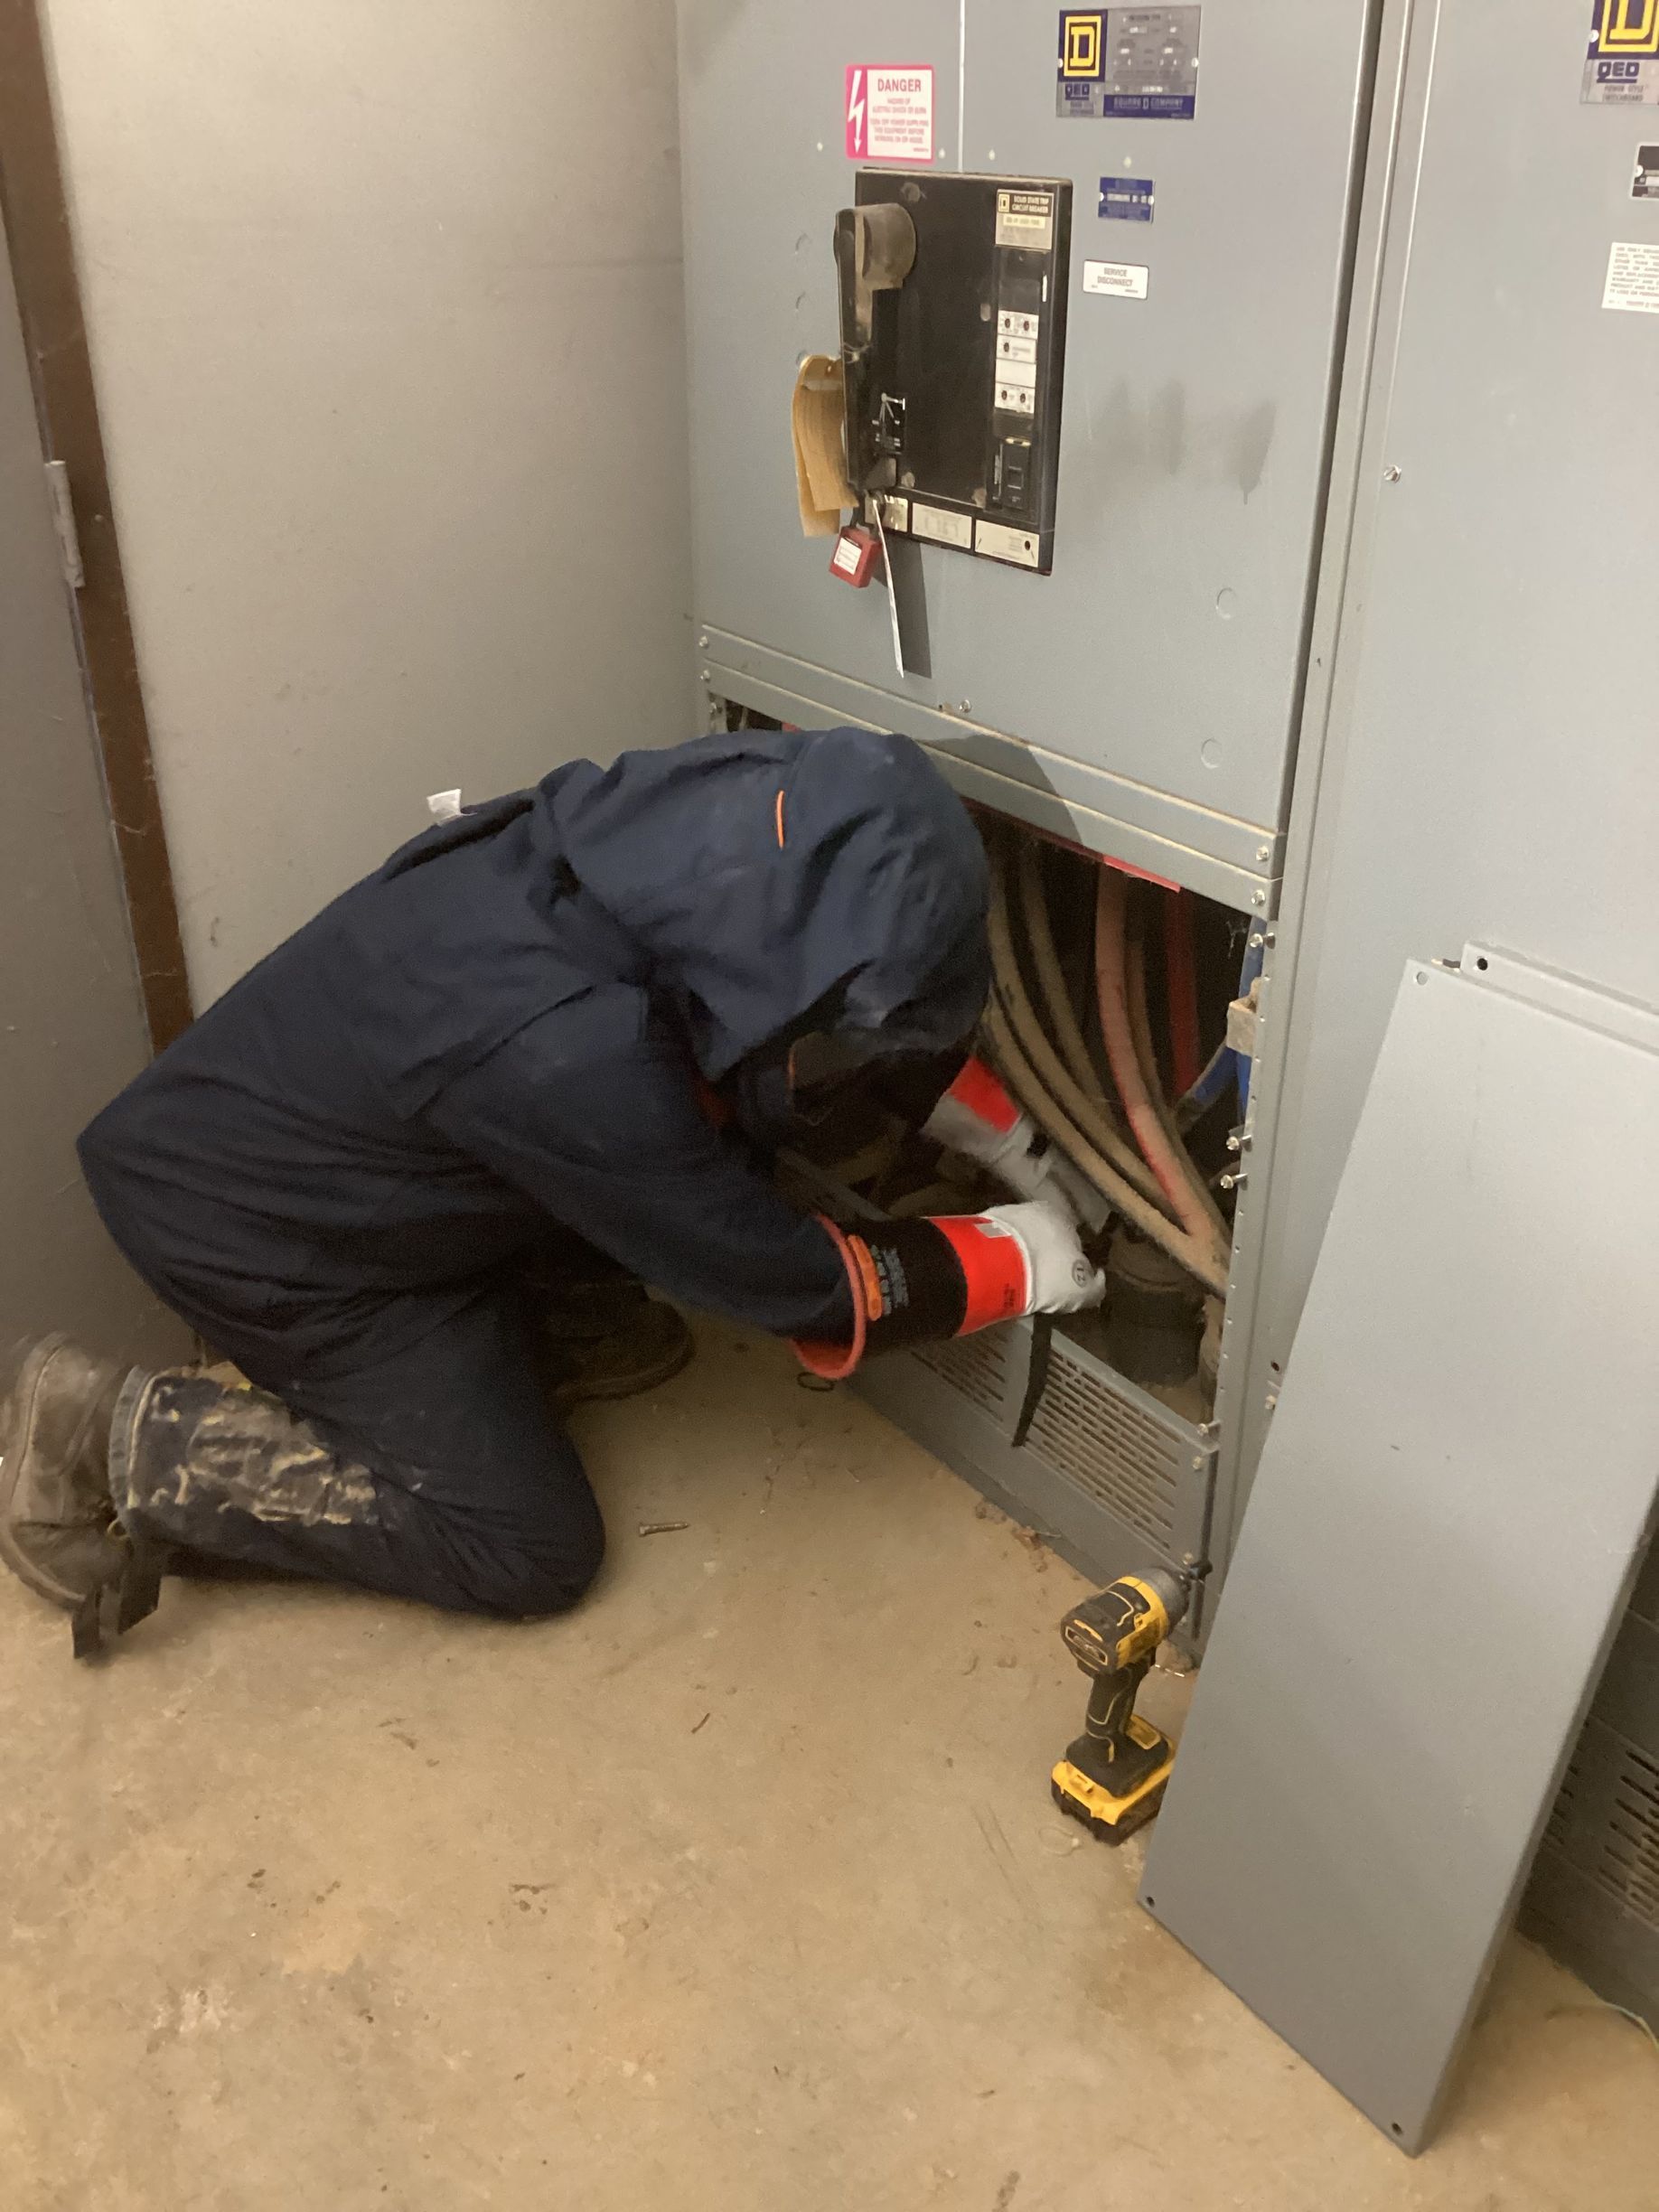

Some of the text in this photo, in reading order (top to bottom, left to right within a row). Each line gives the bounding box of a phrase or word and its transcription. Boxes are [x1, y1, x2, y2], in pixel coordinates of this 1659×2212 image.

[1597, 61, 1640, 81] QED
[877, 79, 922, 92] DANGER
[1103, 267, 1128, 277] SERVICE
[1097, 275, 1134, 287] DISCONNECT
